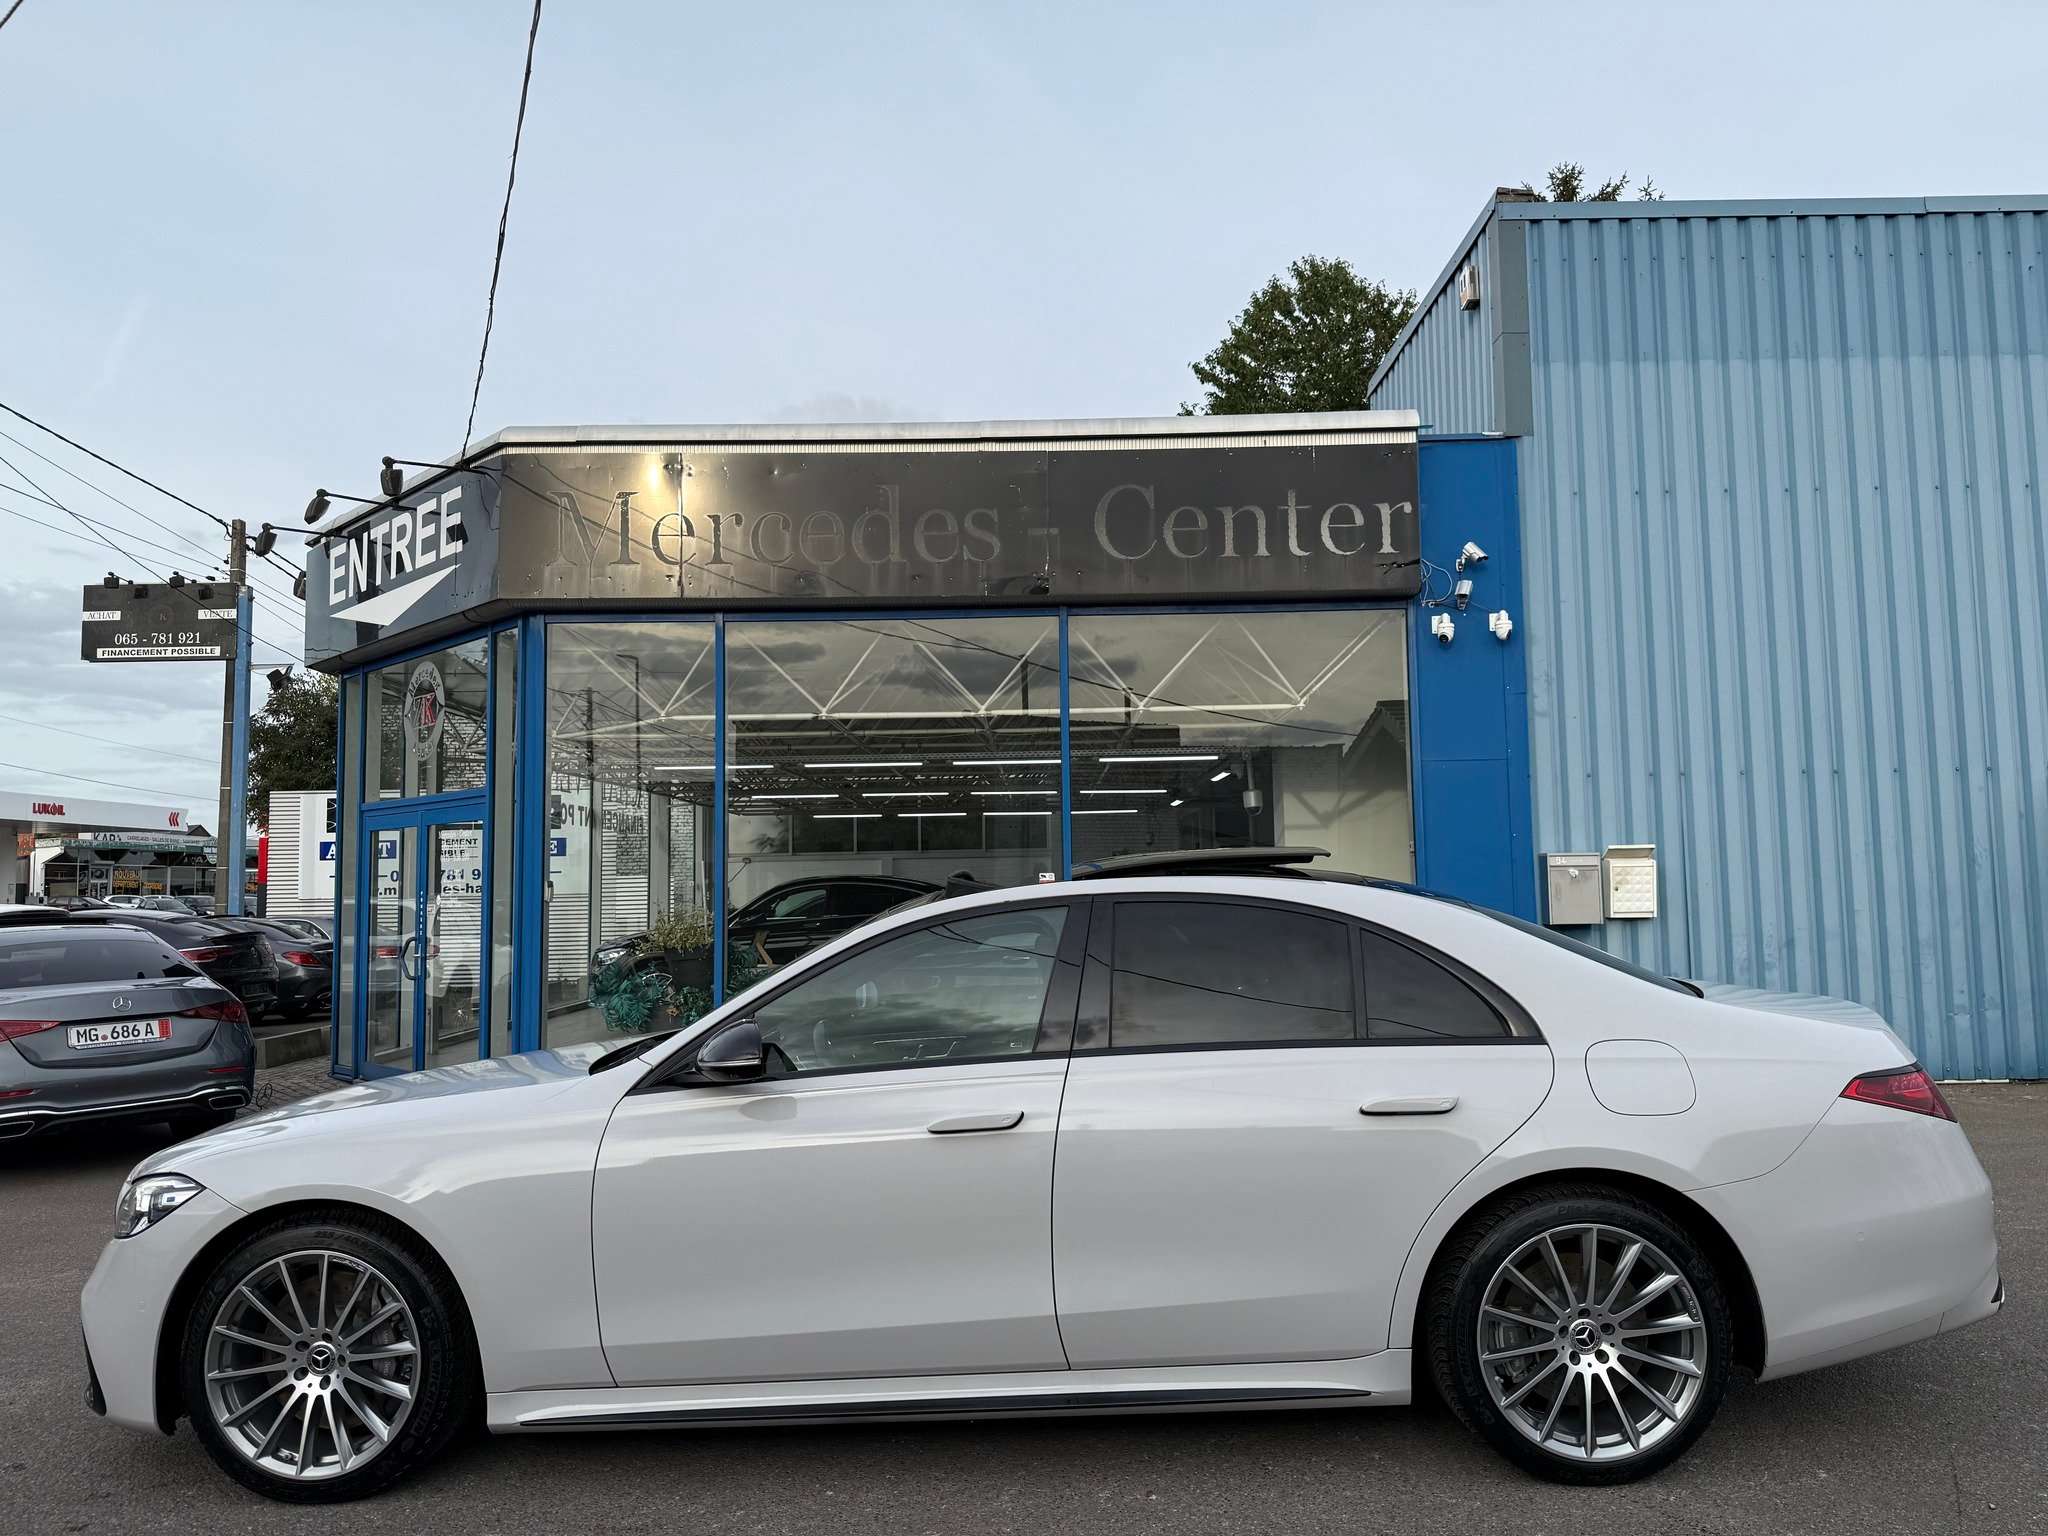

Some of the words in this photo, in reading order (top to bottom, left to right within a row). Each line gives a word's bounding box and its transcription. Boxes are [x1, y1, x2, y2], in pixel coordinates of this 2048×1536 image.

[544, 485, 1001, 567] Mercedes
[1094, 484, 1413, 560] Center
[329, 485, 463, 606] ENTREE
[87, 611, 117, 620] ACHAT
[203, 609, 233, 618] VENTE
[114, 632, 138, 645] 065
[151, 632, 173, 645] 781
[178, 631, 201, 644] 921
[102, 648, 170, 657] FINANCEMENT
[172, 647, 216, 655] POSSIBLE
[32, 802, 66, 816] LUKOIL
[76, 1027, 99, 1043] MG
[110, 1024, 141, 1040] 686
[144, 1022, 154, 1037] A
